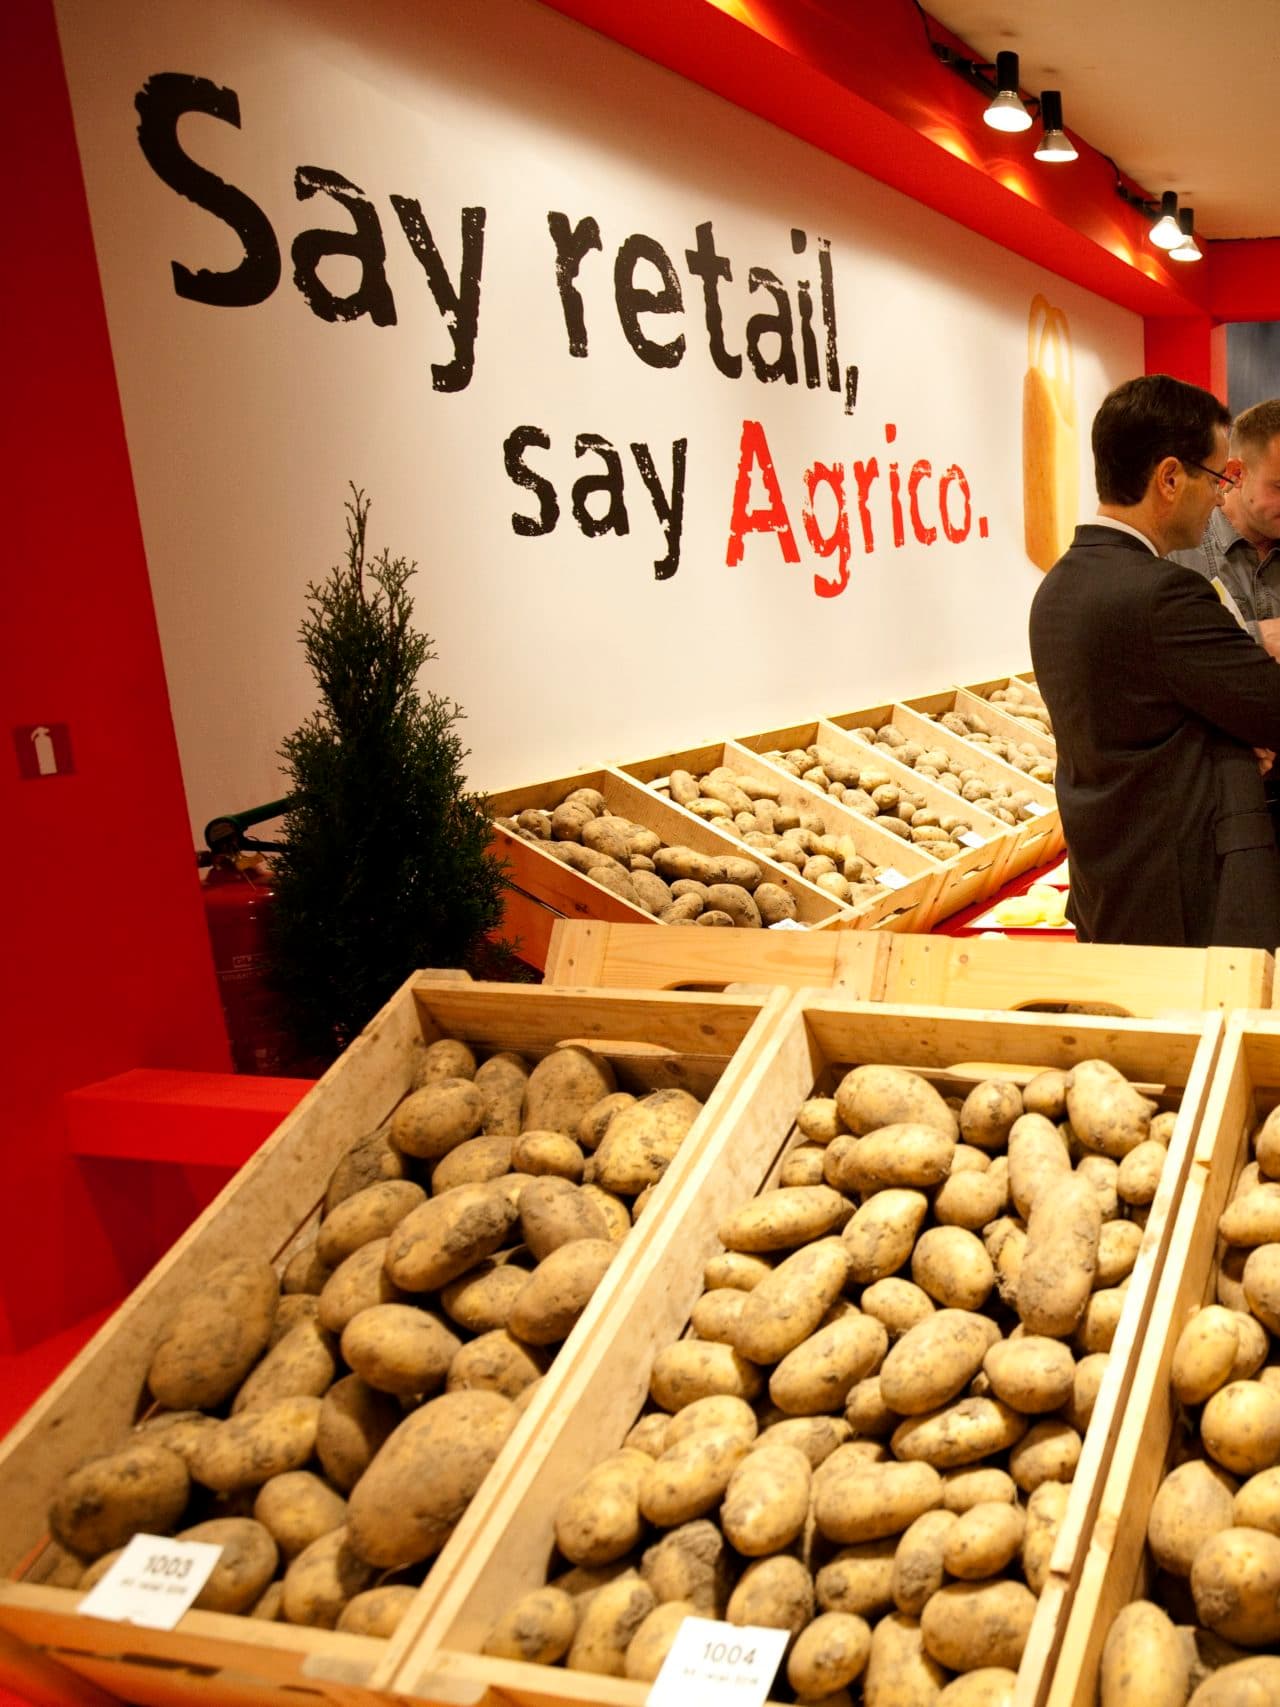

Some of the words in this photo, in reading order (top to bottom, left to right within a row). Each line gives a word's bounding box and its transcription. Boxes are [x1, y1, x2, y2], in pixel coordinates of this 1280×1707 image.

[134, 71, 486, 393] Say
[547, 210, 859, 415] retail,
[502, 423, 688, 581] say
[726, 420, 990, 599] Agrico.
[143, 1555, 195, 1579] 1003
[703, 1641, 757, 1665] 1004
